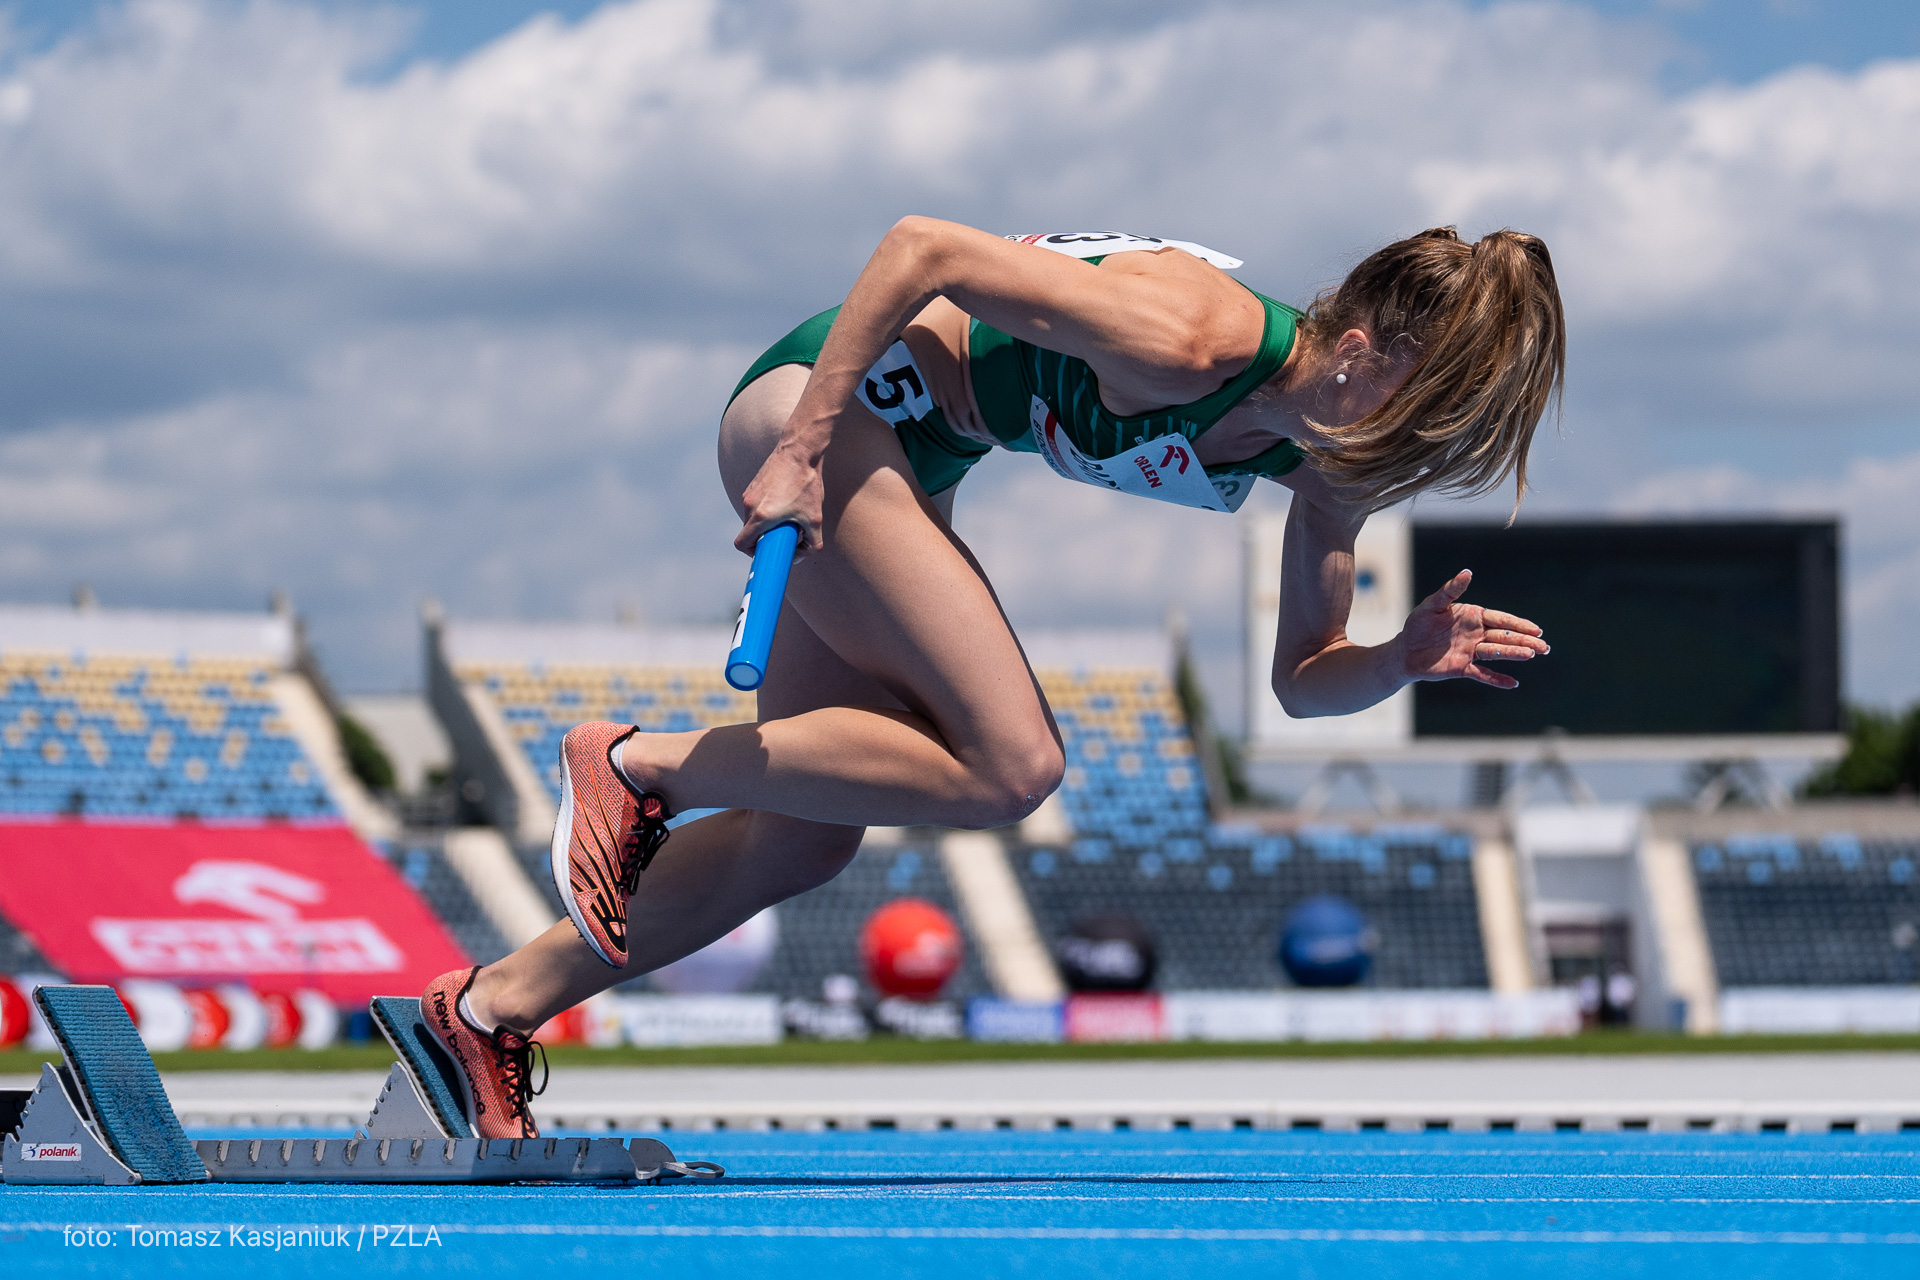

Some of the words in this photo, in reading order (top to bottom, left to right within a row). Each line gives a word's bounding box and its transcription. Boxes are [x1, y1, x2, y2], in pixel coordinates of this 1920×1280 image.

[865, 364, 924, 410] 5
[1133, 455, 1163, 489] ORLEN
[433, 991, 450, 1030] new
[446, 1031, 486, 1115] balance
[39, 1146, 78, 1159] polanik
